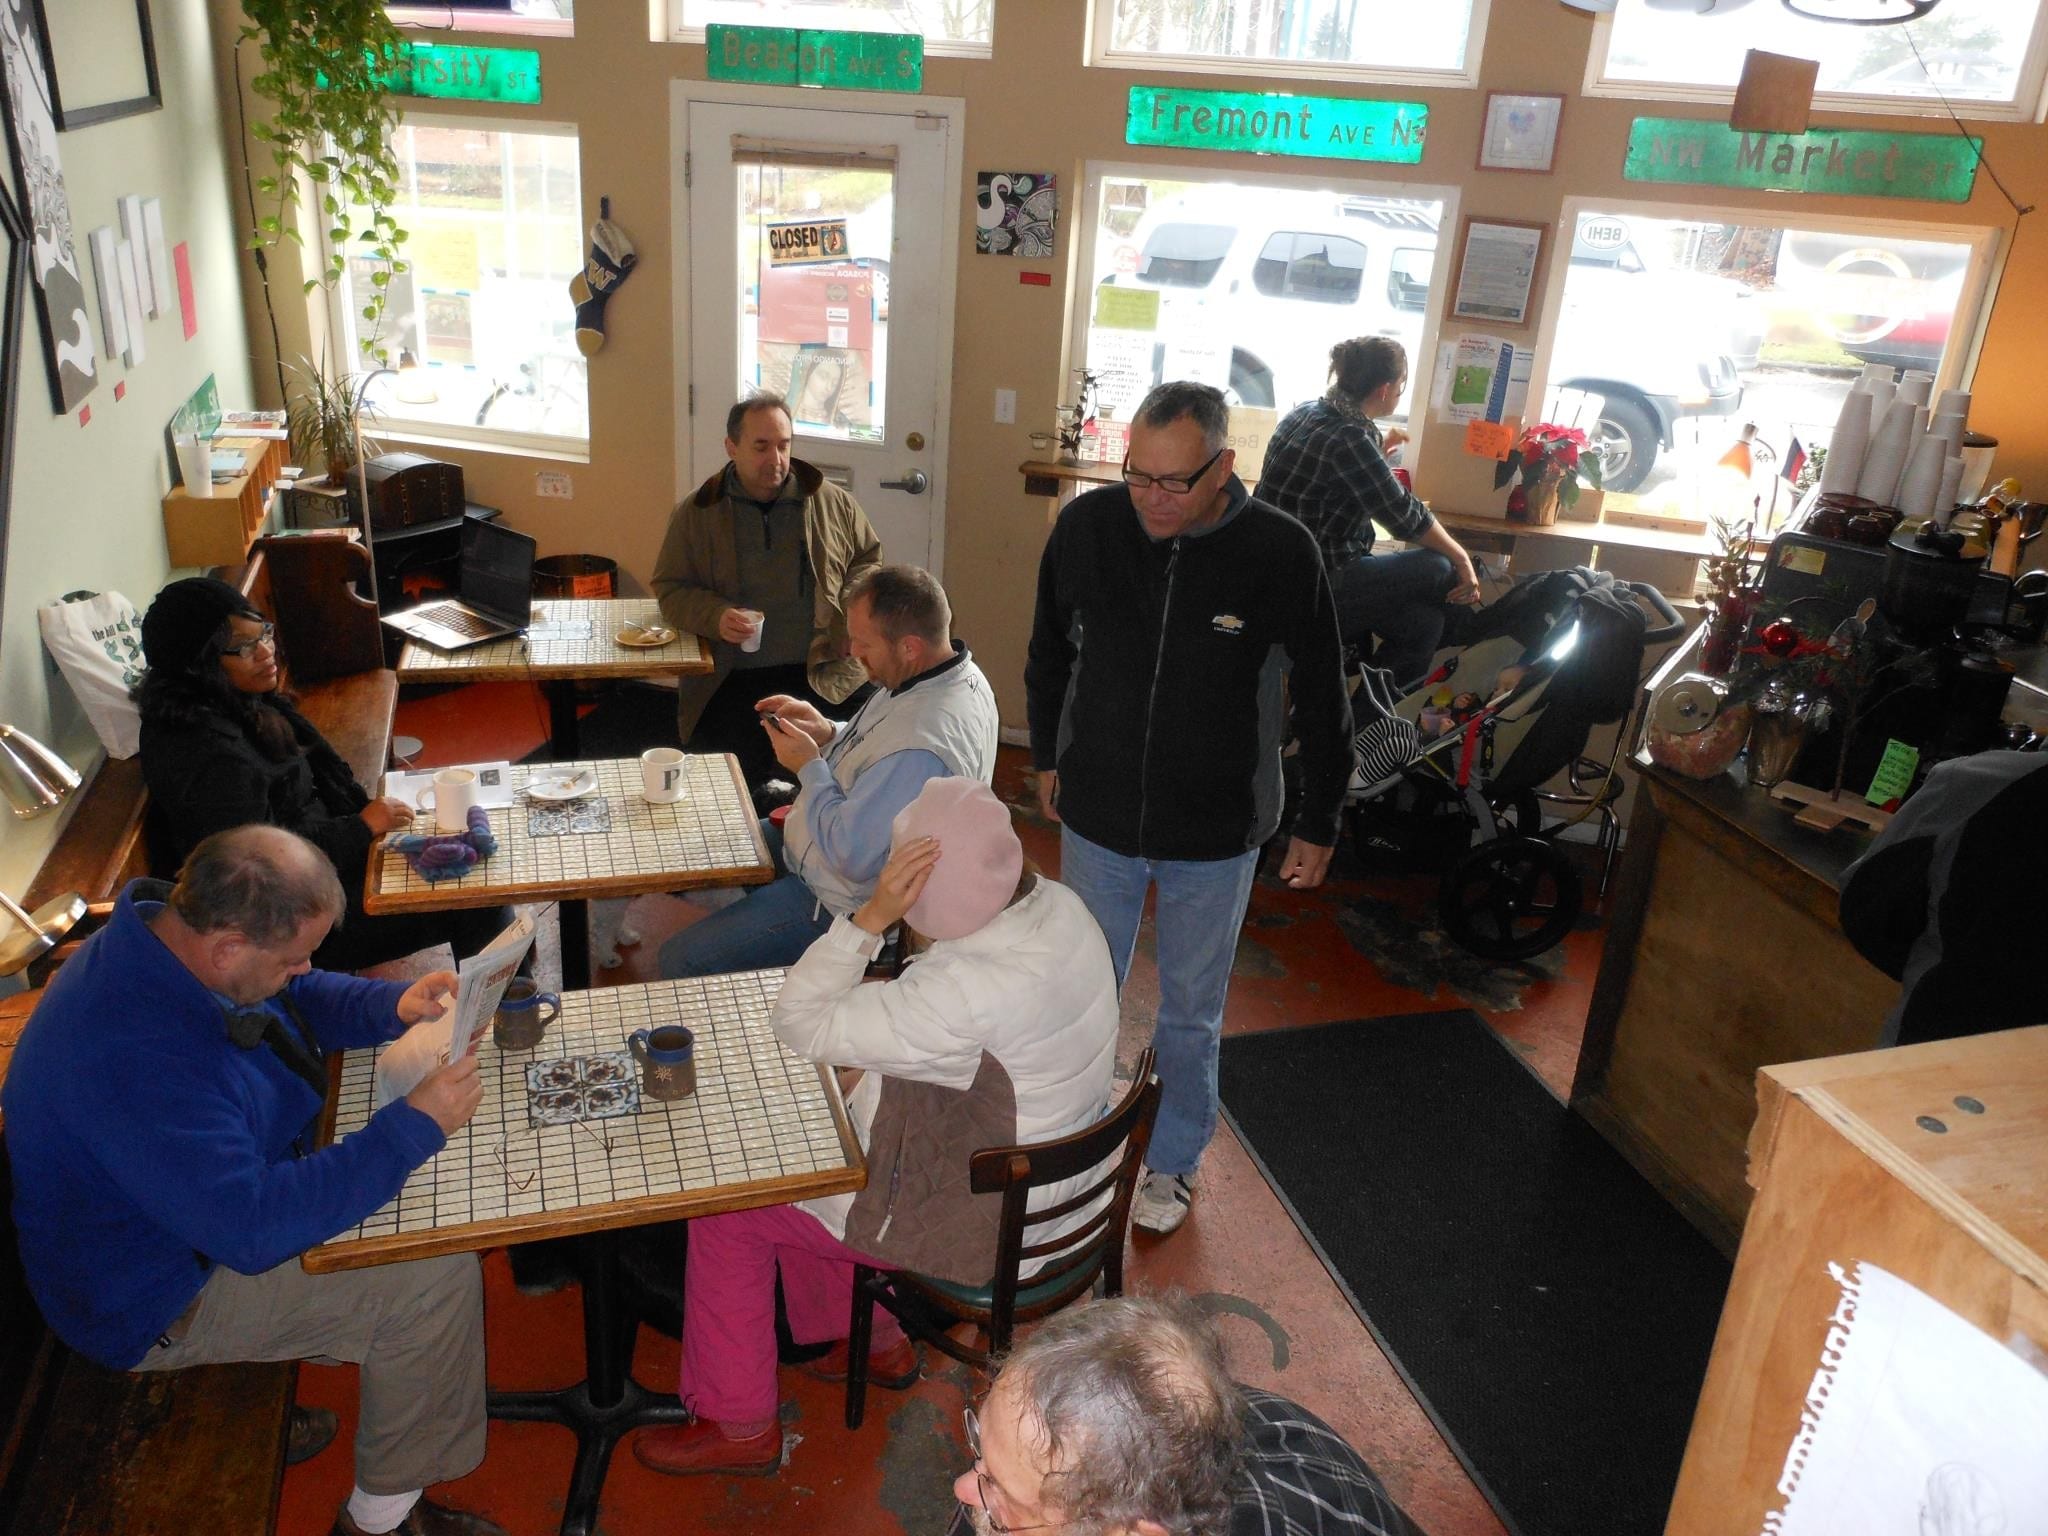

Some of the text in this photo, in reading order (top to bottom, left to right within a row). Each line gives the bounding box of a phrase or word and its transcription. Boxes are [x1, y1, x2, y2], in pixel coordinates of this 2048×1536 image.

[398, 53, 528, 90] ersity ST
[723, 31, 914, 79] Beacon AVE S
[1151, 94, 1413, 148] Fremont AVE N
[1650, 136, 1706, 169] NW
[1735, 132, 1904, 182] Market
[770, 227, 818, 250] CLOSED
[587, 258, 617, 291] W
[662, 768, 681, 791] P
